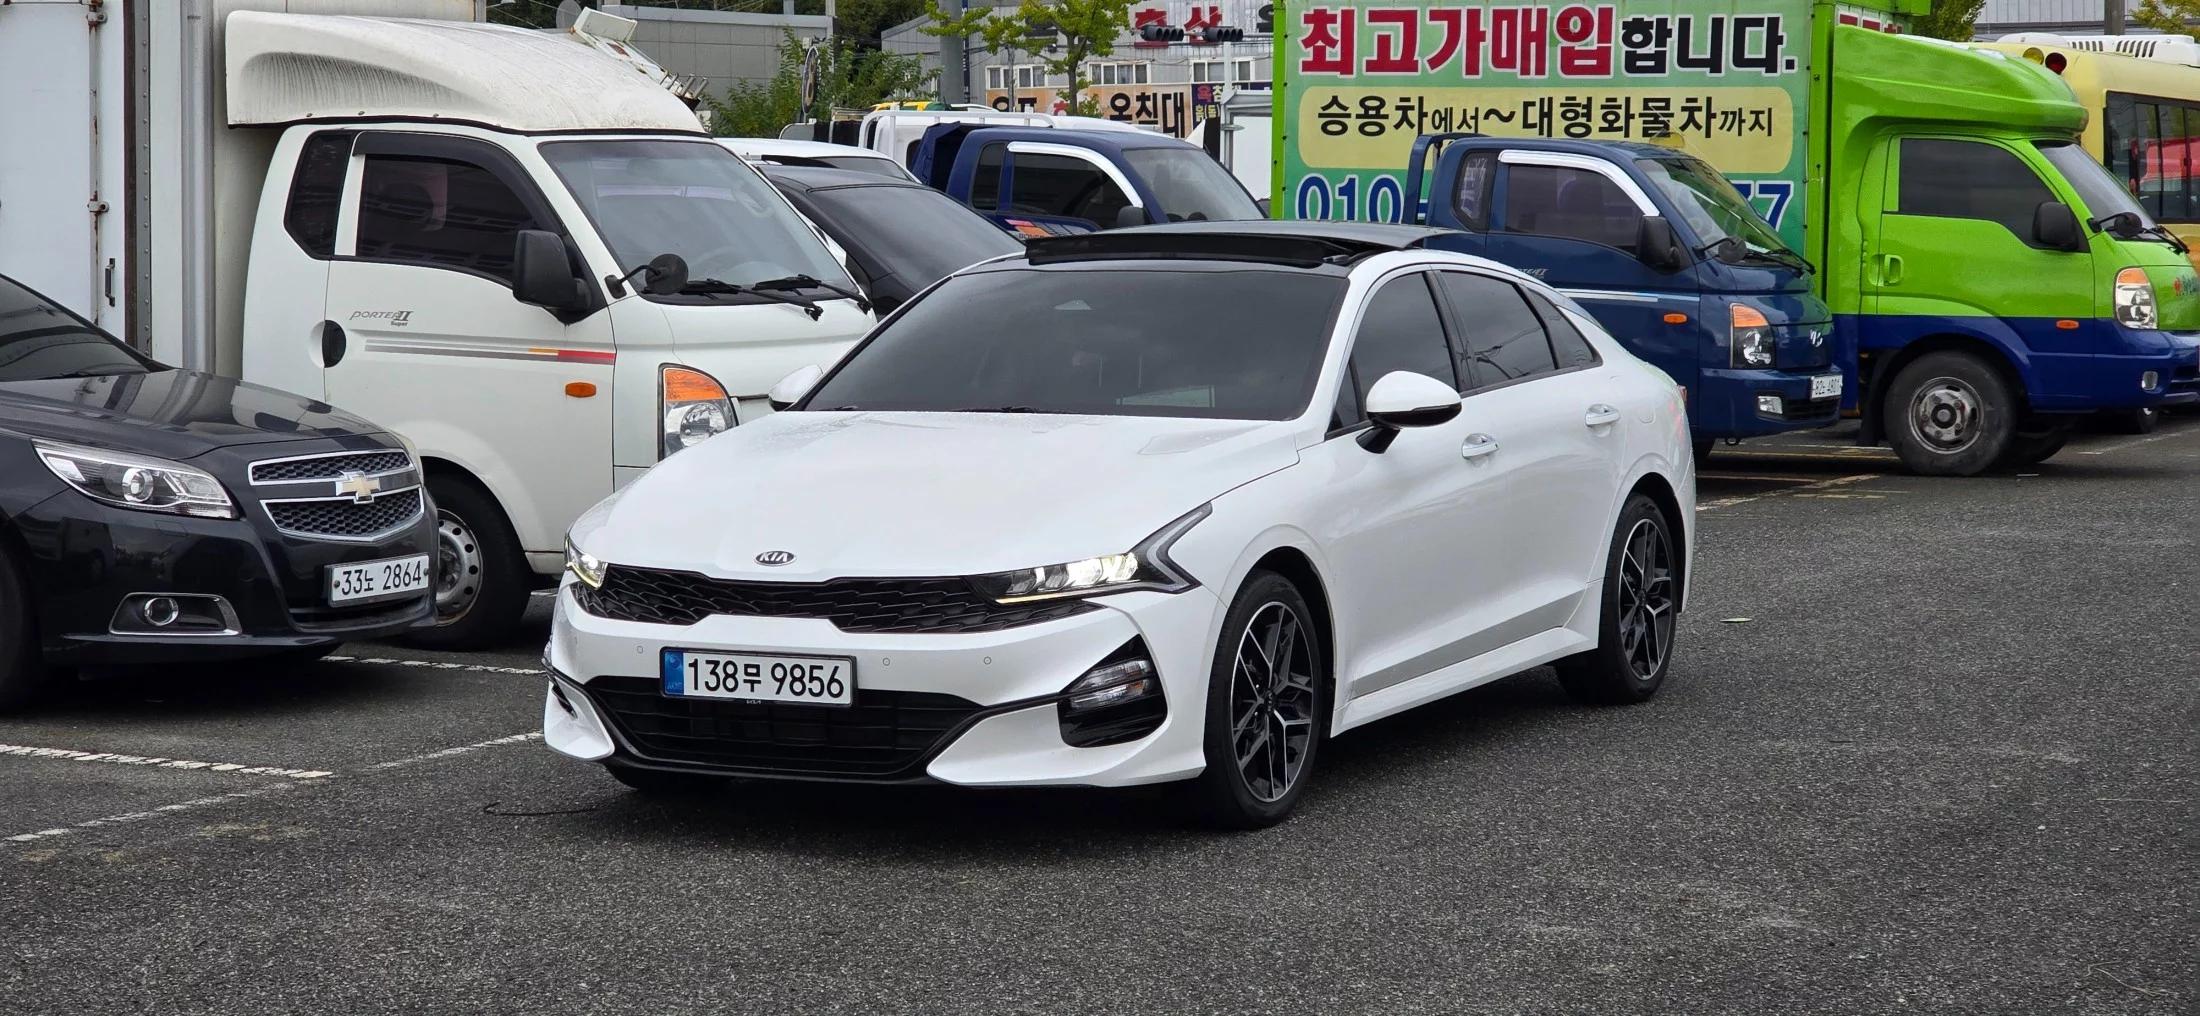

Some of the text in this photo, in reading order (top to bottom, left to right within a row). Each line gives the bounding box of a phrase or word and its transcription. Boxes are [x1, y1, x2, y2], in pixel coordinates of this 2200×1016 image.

[759, 552, 790, 563] KIA
[341, 560, 422, 596] 33노 2864
[688, 658, 845, 699] 138무 9856
